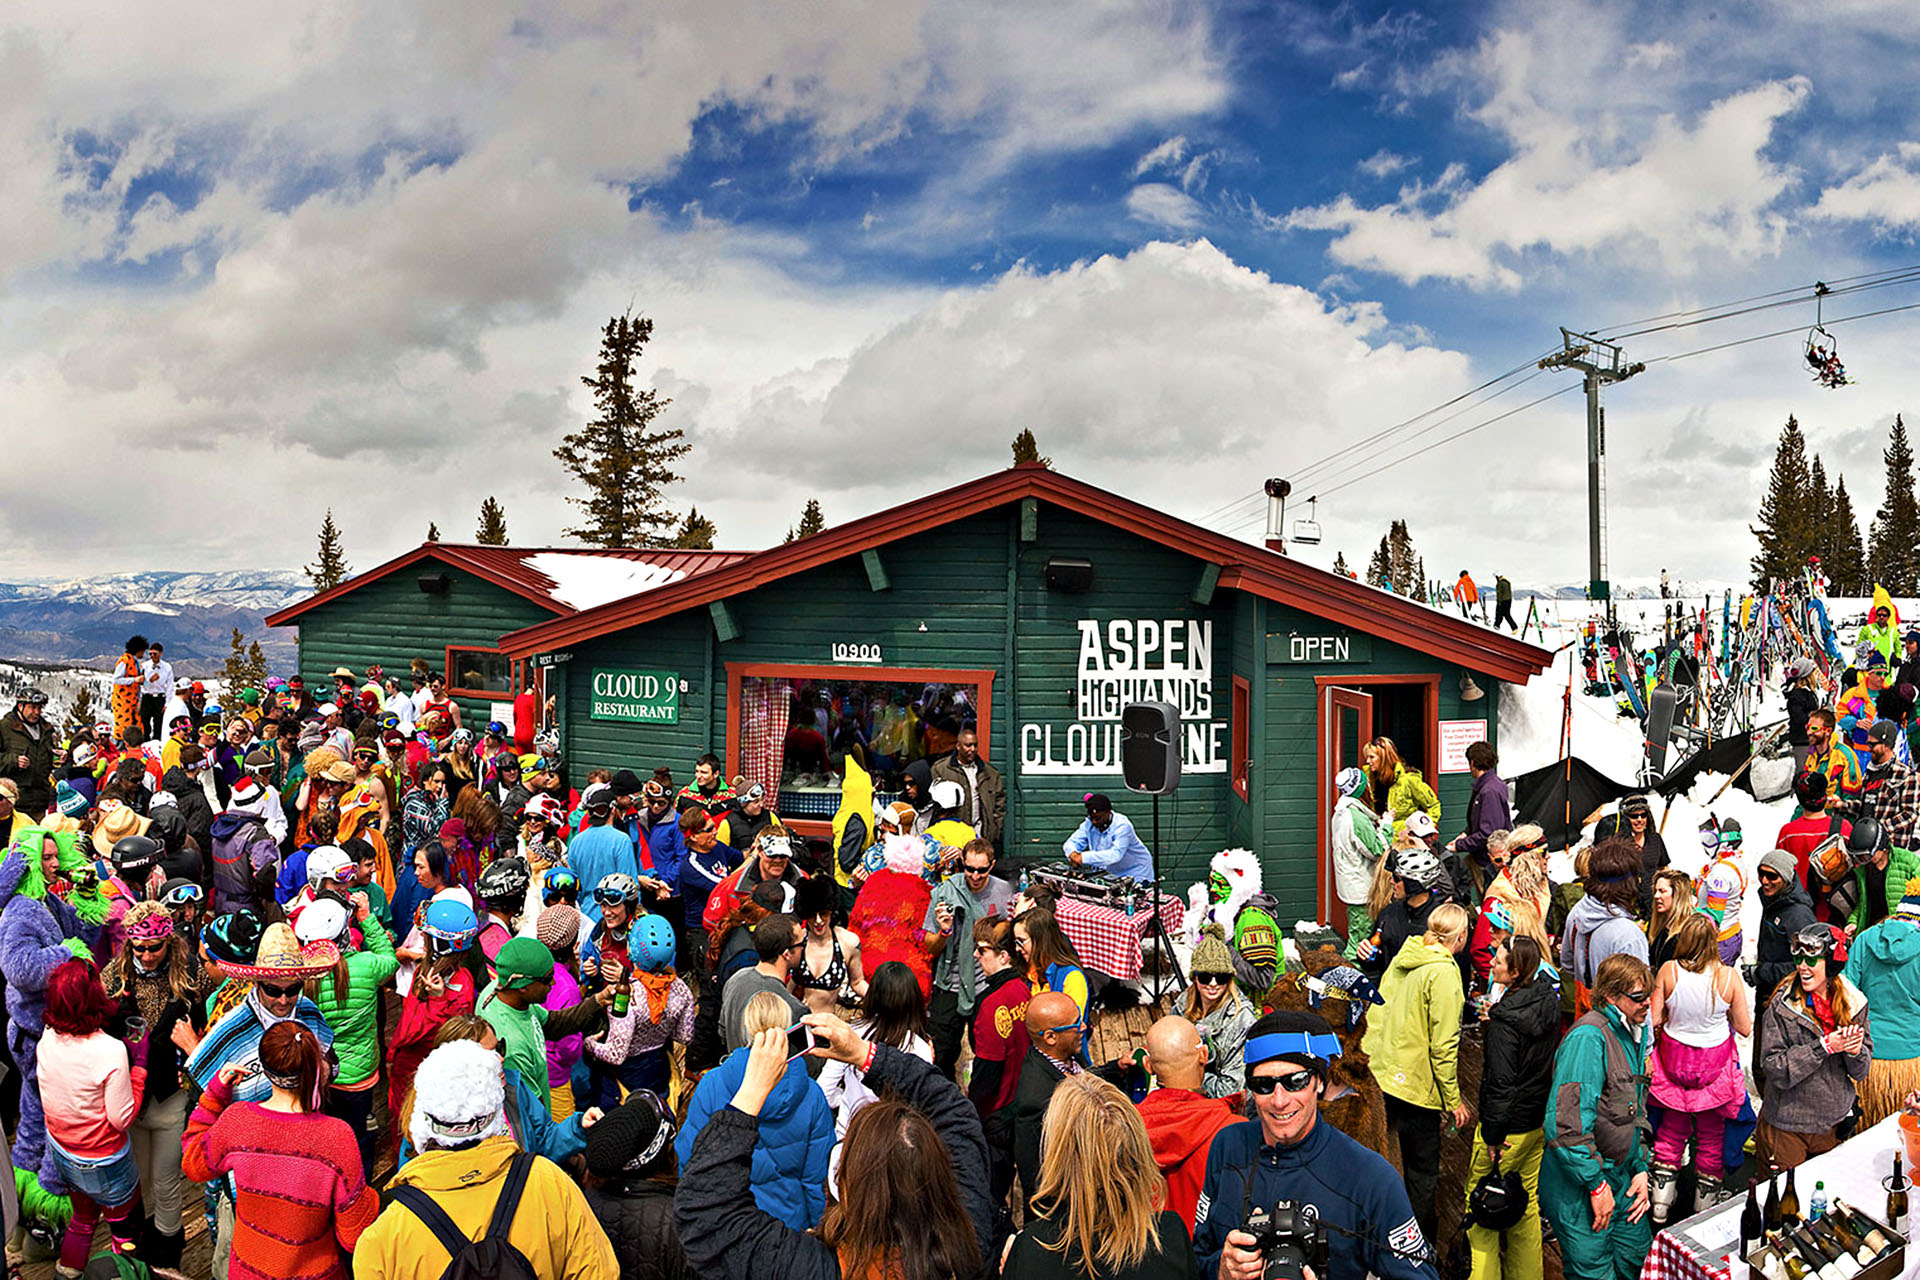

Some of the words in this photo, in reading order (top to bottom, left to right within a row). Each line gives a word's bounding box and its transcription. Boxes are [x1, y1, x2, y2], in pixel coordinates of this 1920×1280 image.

[832, 643, 882, 660] 10900
[1078, 620, 1212, 672] ASPEN
[1291, 637, 1349, 660] OPEN
[593, 673, 659, 699] CLOUD
[665, 676, 677, 703] 9
[594, 702, 675, 719] RESTAURANT
[1181, 723, 1227, 769] INE
